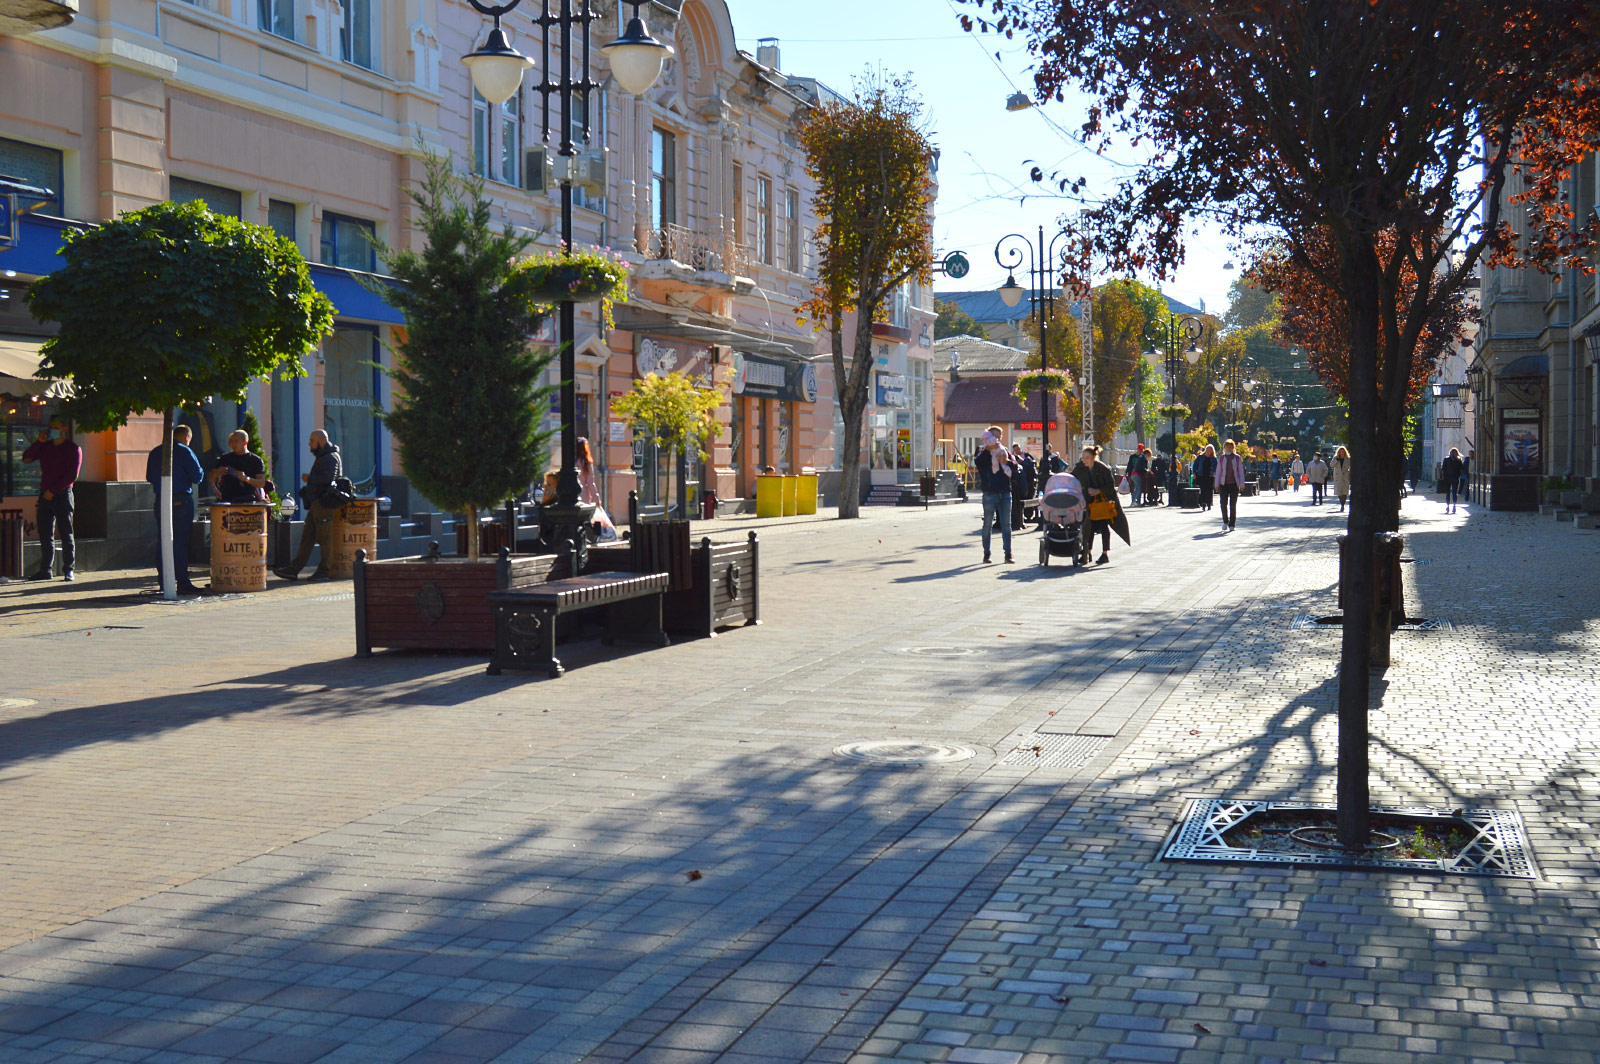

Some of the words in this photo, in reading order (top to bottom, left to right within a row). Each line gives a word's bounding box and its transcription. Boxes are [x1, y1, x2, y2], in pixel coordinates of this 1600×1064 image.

[323, 398, 345, 406] ЕНСКАЯ
[343, 534, 368, 543] LATTE
[223, 543, 251, 553] LATTE
